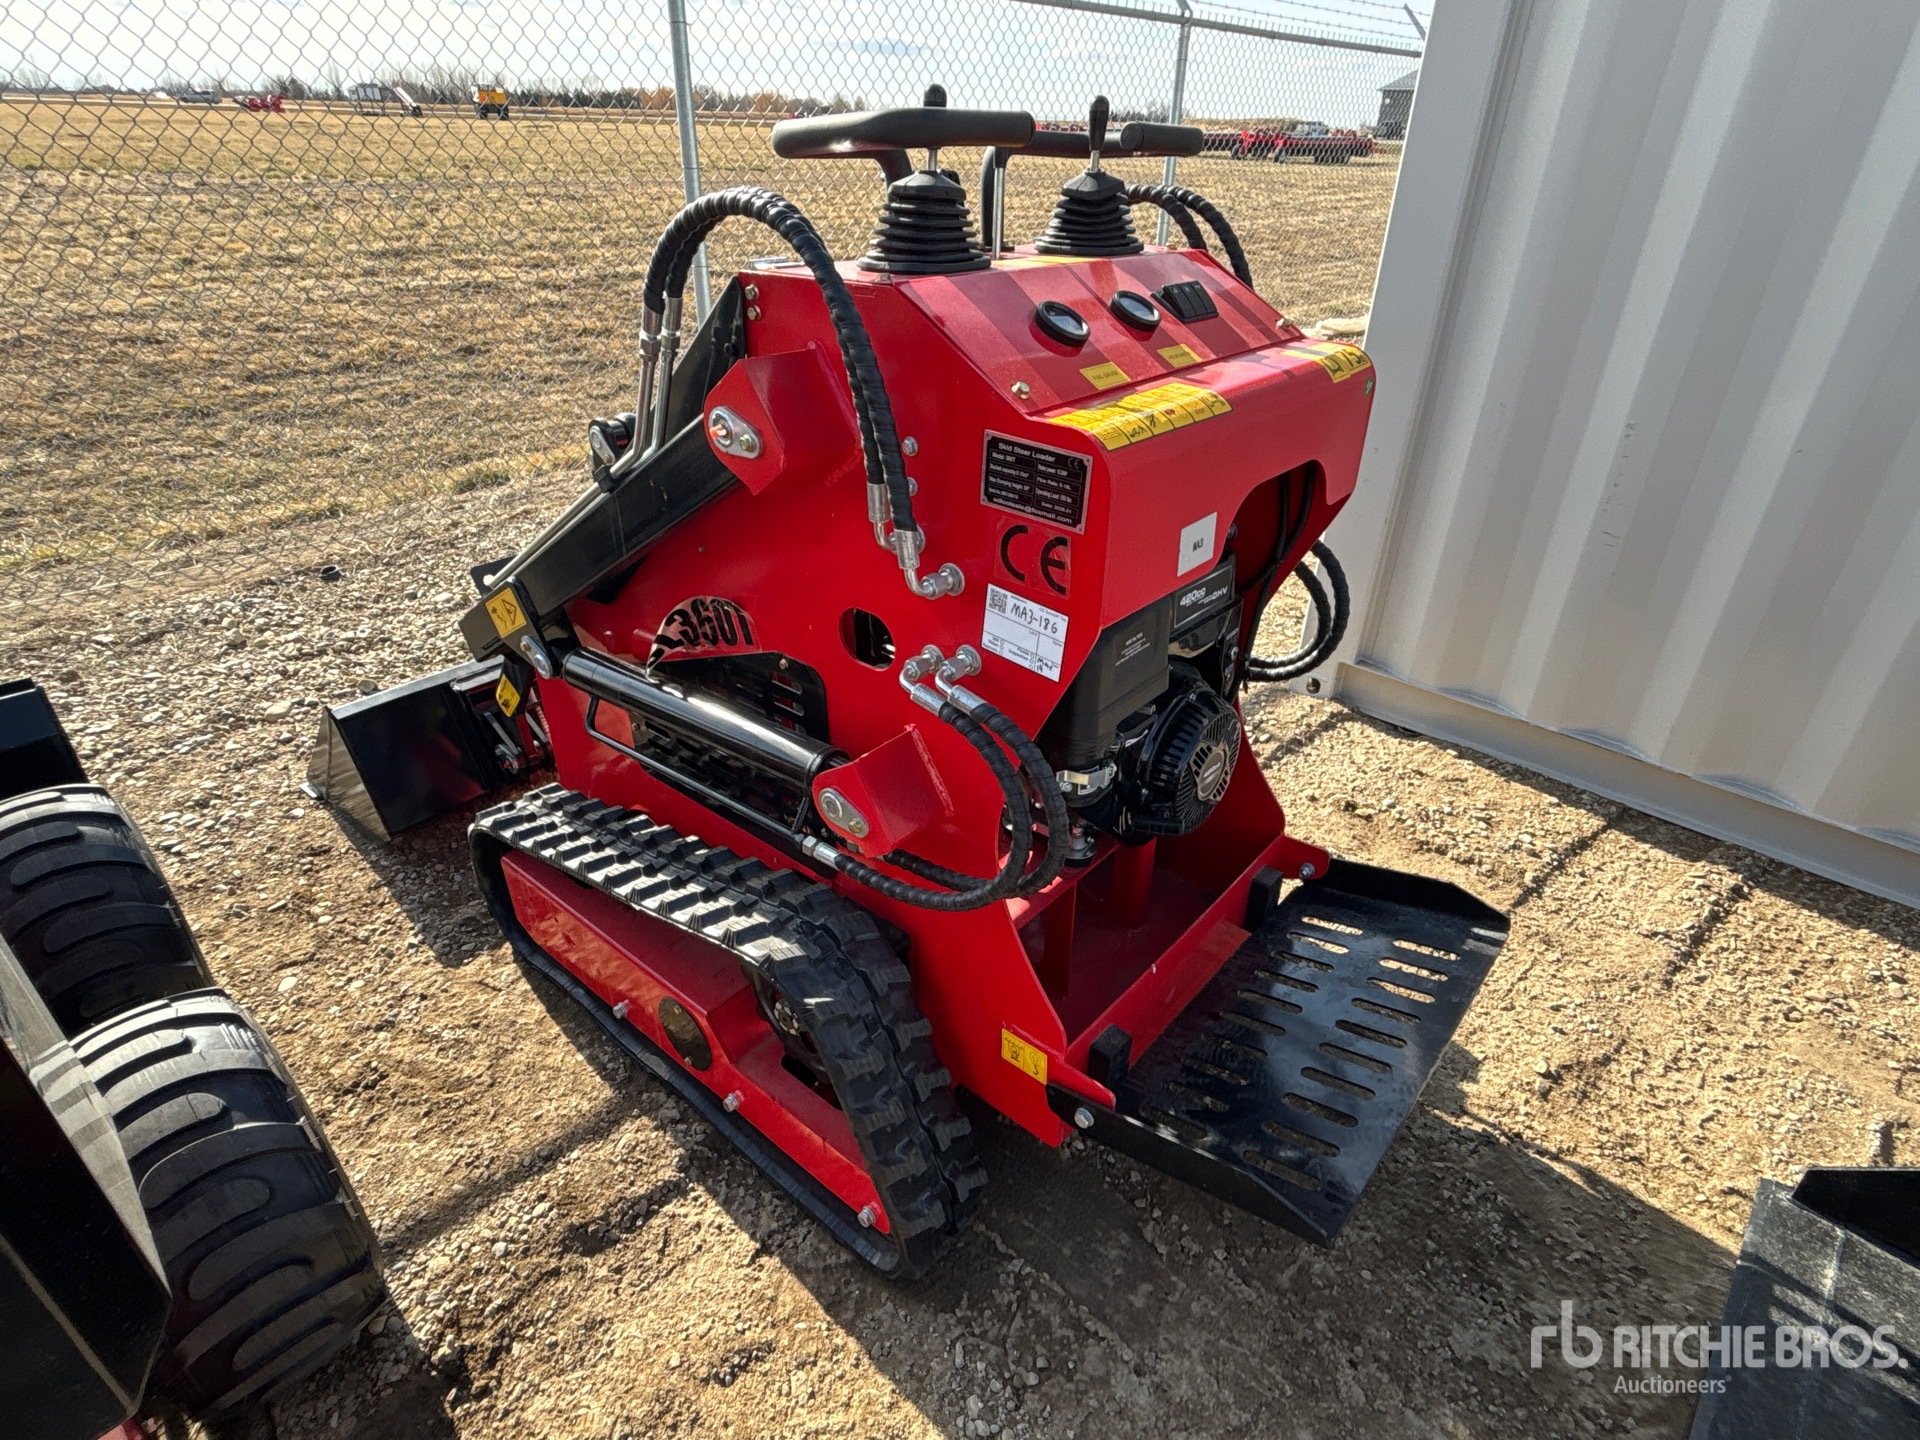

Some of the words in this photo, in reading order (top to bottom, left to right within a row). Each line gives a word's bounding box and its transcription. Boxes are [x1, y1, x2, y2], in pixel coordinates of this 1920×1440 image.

[998, 442, 1012, 452] Skid
[1014, 446, 1031, 456] Steer
[1032, 451, 1056, 462] Loader
[1001, 524, 1068, 595] CE
[1180, 586, 1206, 606] 420cc
[1011, 603, 1058, 634] MA3-186
